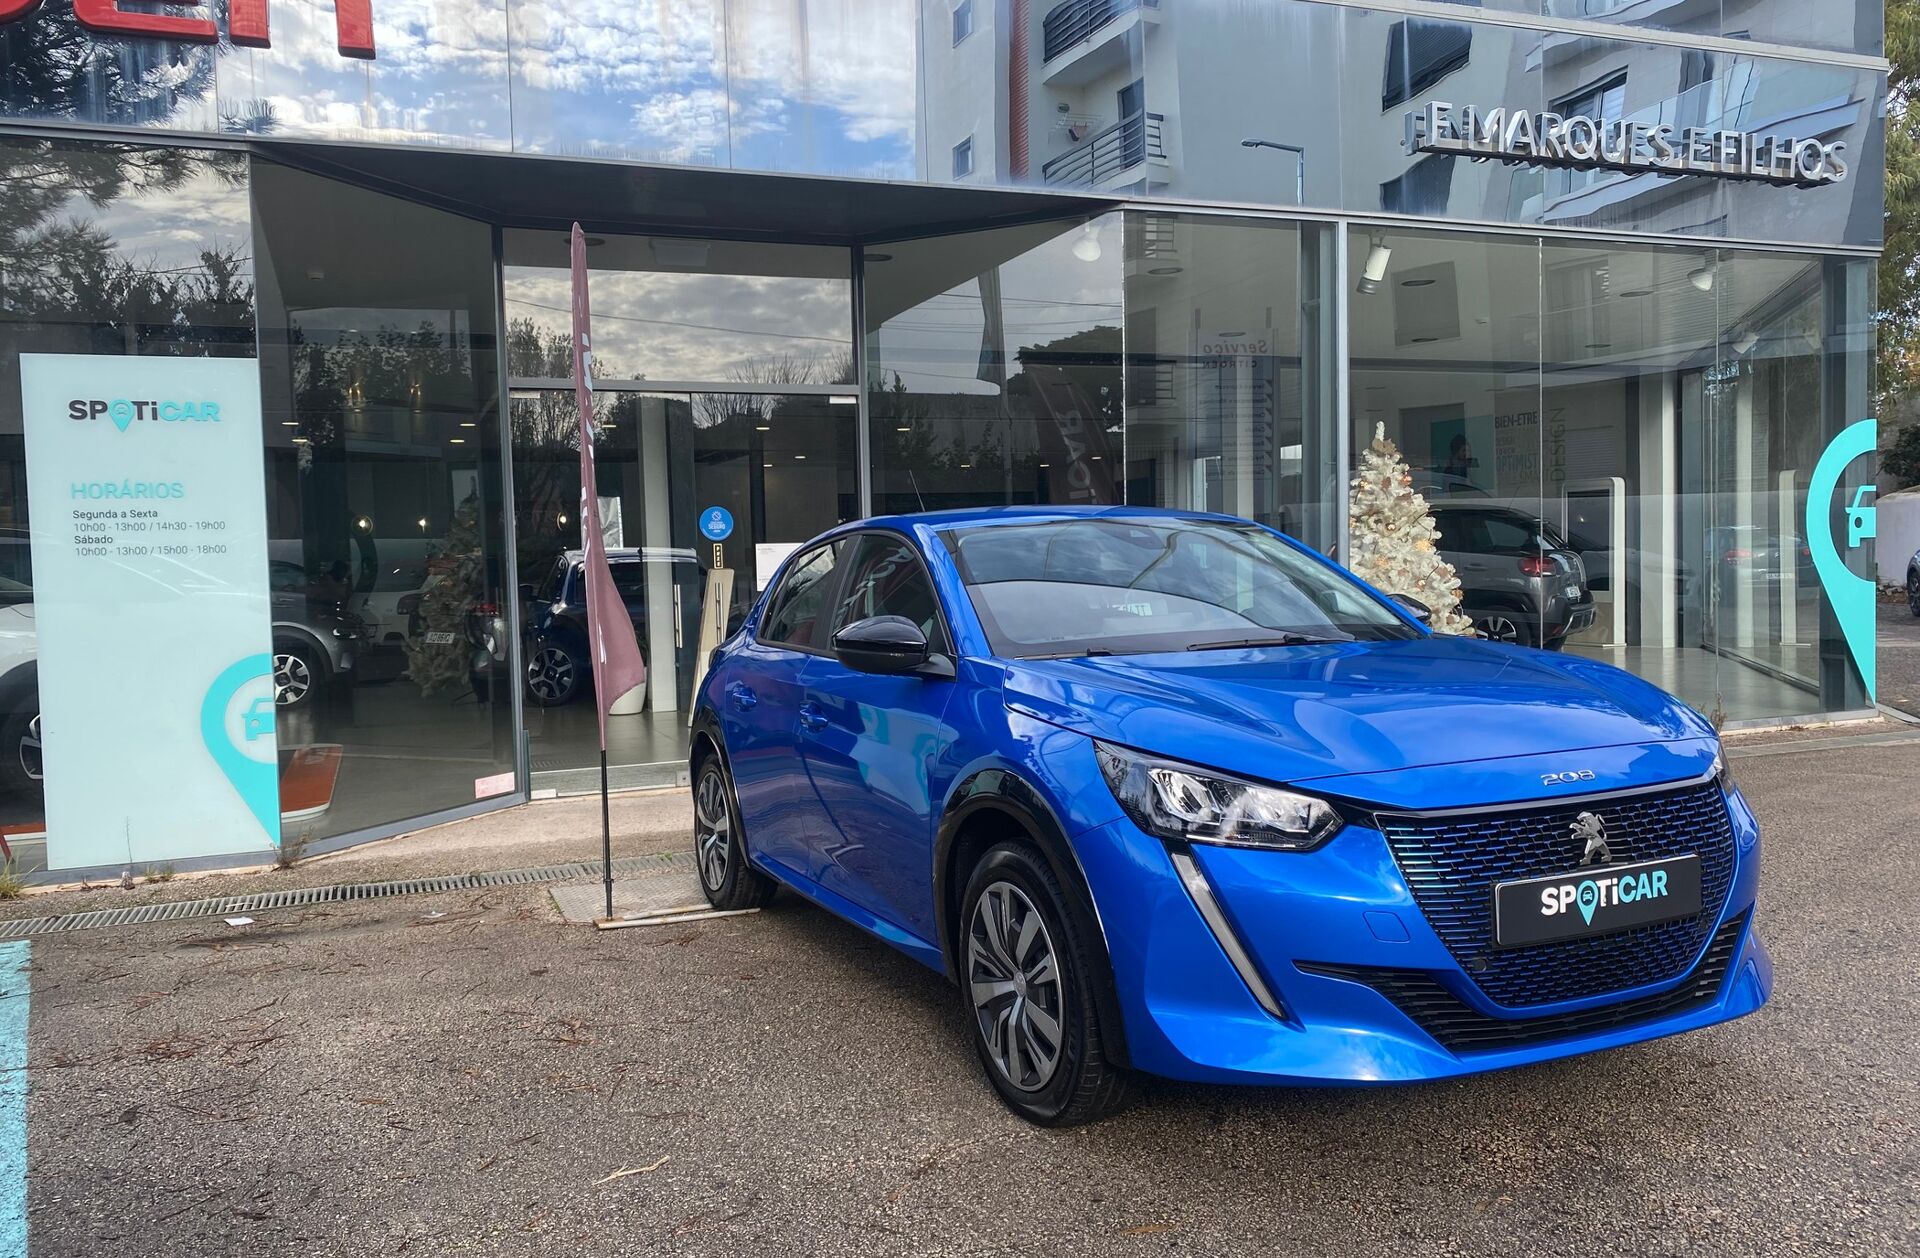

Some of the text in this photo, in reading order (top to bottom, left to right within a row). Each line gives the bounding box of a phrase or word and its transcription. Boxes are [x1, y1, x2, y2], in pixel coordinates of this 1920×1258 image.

[1463, 104, 1675, 167] MARQUES
[1682, 127, 1712, 171] E
[1714, 130, 1848, 183] FILHOS
[1549, 407, 1566, 482] DESIGN
[70, 478, 185, 500] HORÁRIOS
[72, 509, 118, 520] Segunda
[129, 509, 158, 518] Sexta
[74, 522, 106, 532] 10h00
[115, 522, 146, 531] 13h00
[156, 521, 187, 531] 14h30
[196, 520, 226, 530] 19h00
[74, 534, 114, 544] Sábado
[76, 546, 107, 556] 10h00
[117, 545, 147, 556] 13h00
[158, 545, 188, 555] 15h00
[197, 544, 227, 554] 18h00
[1540, 769, 1596, 786] 208
